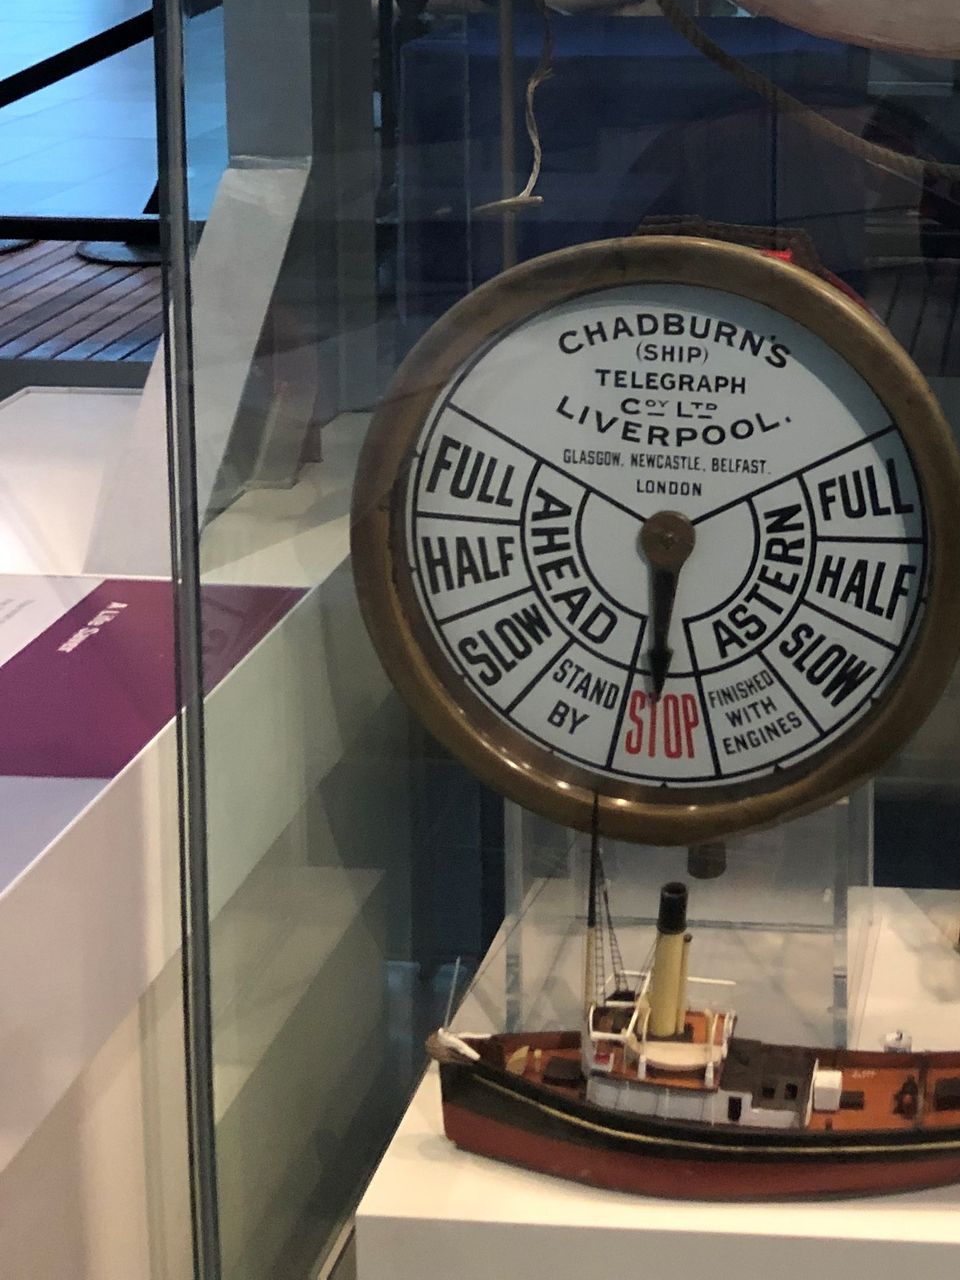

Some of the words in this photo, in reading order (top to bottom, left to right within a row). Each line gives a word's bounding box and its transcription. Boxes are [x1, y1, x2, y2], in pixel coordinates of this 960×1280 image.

[558, 312, 792, 369] CHADBURN'S
[636, 341, 709, 365] (SHIP)
[595, 368, 746, 394] TELEGRAPH
[556, 395, 792, 448] LIVERPOOL.
[425, 434, 515, 507] FULL
[636, 479, 702, 497] LONDON
[817, 458, 914, 520] FULL
[421, 536, 515, 595] HALF
[531, 486, 618, 645] AHEAD
[711, 503, 805, 658] ASTERN
[815, 554, 917, 620] HALF
[457, 603, 552, 687] SLOW
[778, 622, 877, 708] SLOW
[552, 658, 620, 710] STAND
[708, 669, 775, 709] FINISHED
[725, 696, 778, 728] WITH
[547, 699, 589, 735] BY
[624, 689, 699, 759] STOP
[723, 711, 803, 756] ENGINES
